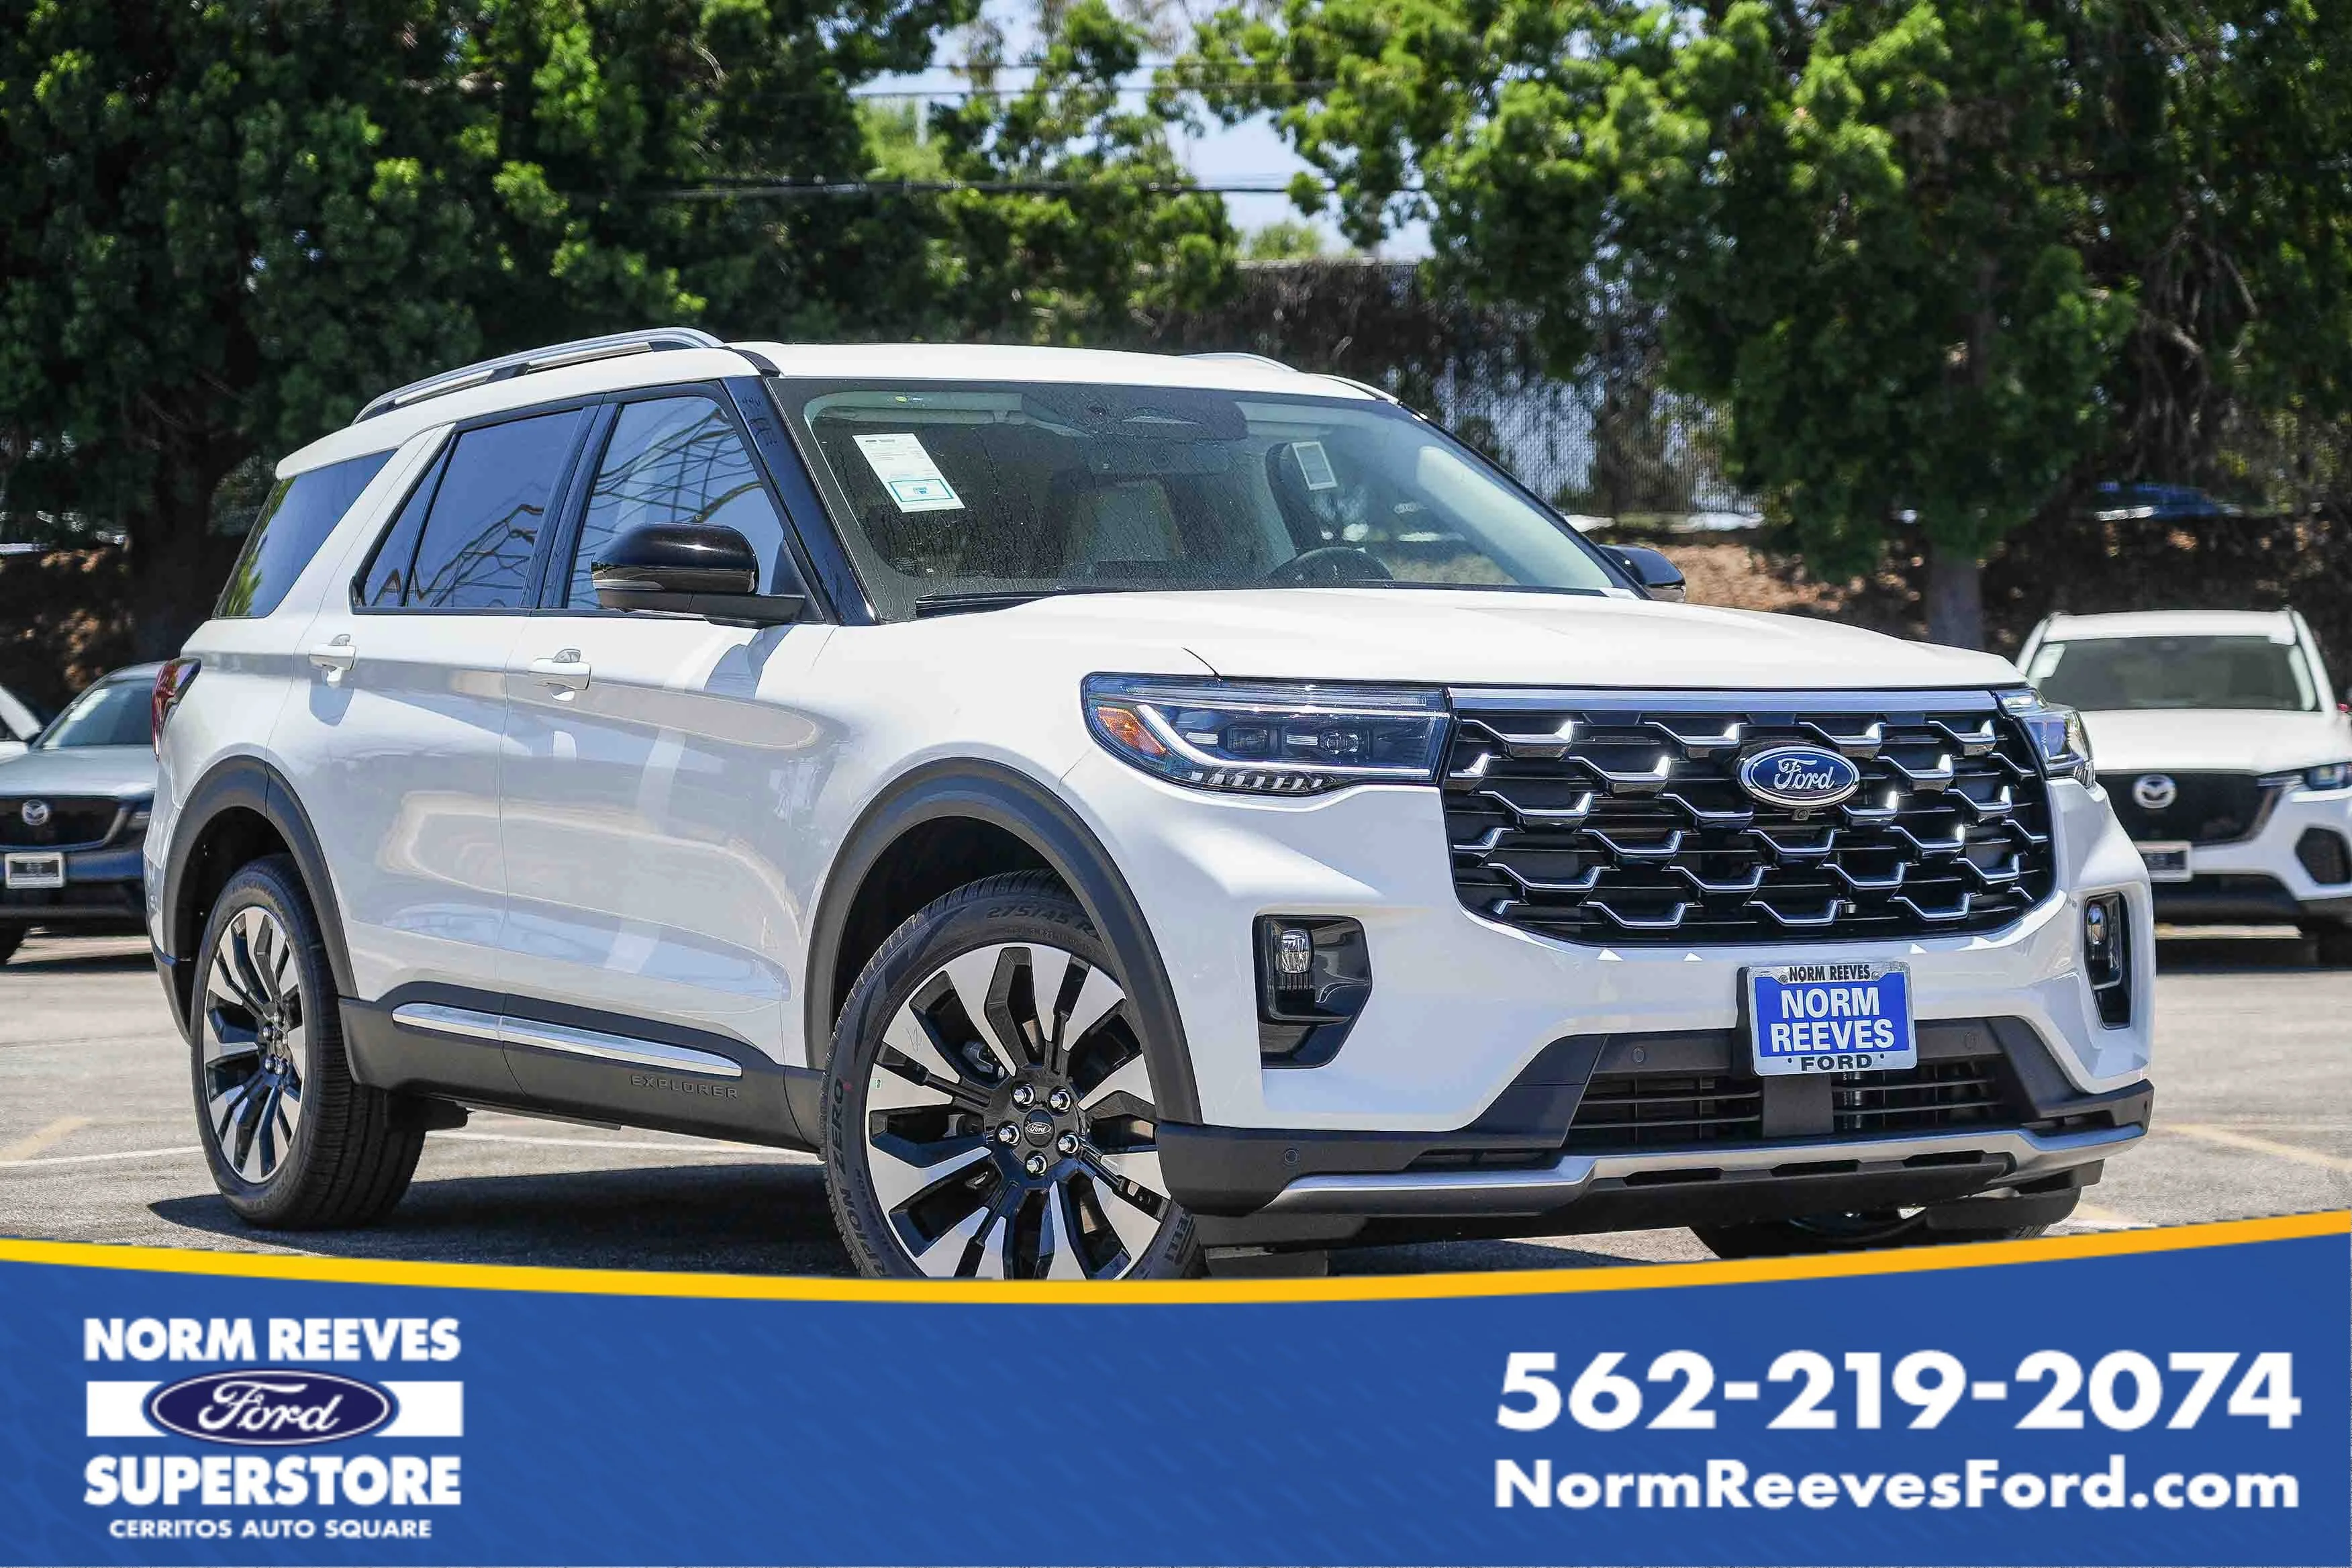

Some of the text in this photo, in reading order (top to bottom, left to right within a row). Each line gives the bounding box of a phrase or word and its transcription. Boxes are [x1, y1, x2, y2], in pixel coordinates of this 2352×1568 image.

[1774, 758, 1835, 790] Ford
[1789, 965, 1871, 982] NORM REEVES
[1781, 987, 1880, 1019] NORM
[1770, 1018, 1896, 1052] REEVES
[1801, 1053, 1873, 1071] FORD
[630, 1075, 738, 1099] EXPLORER
